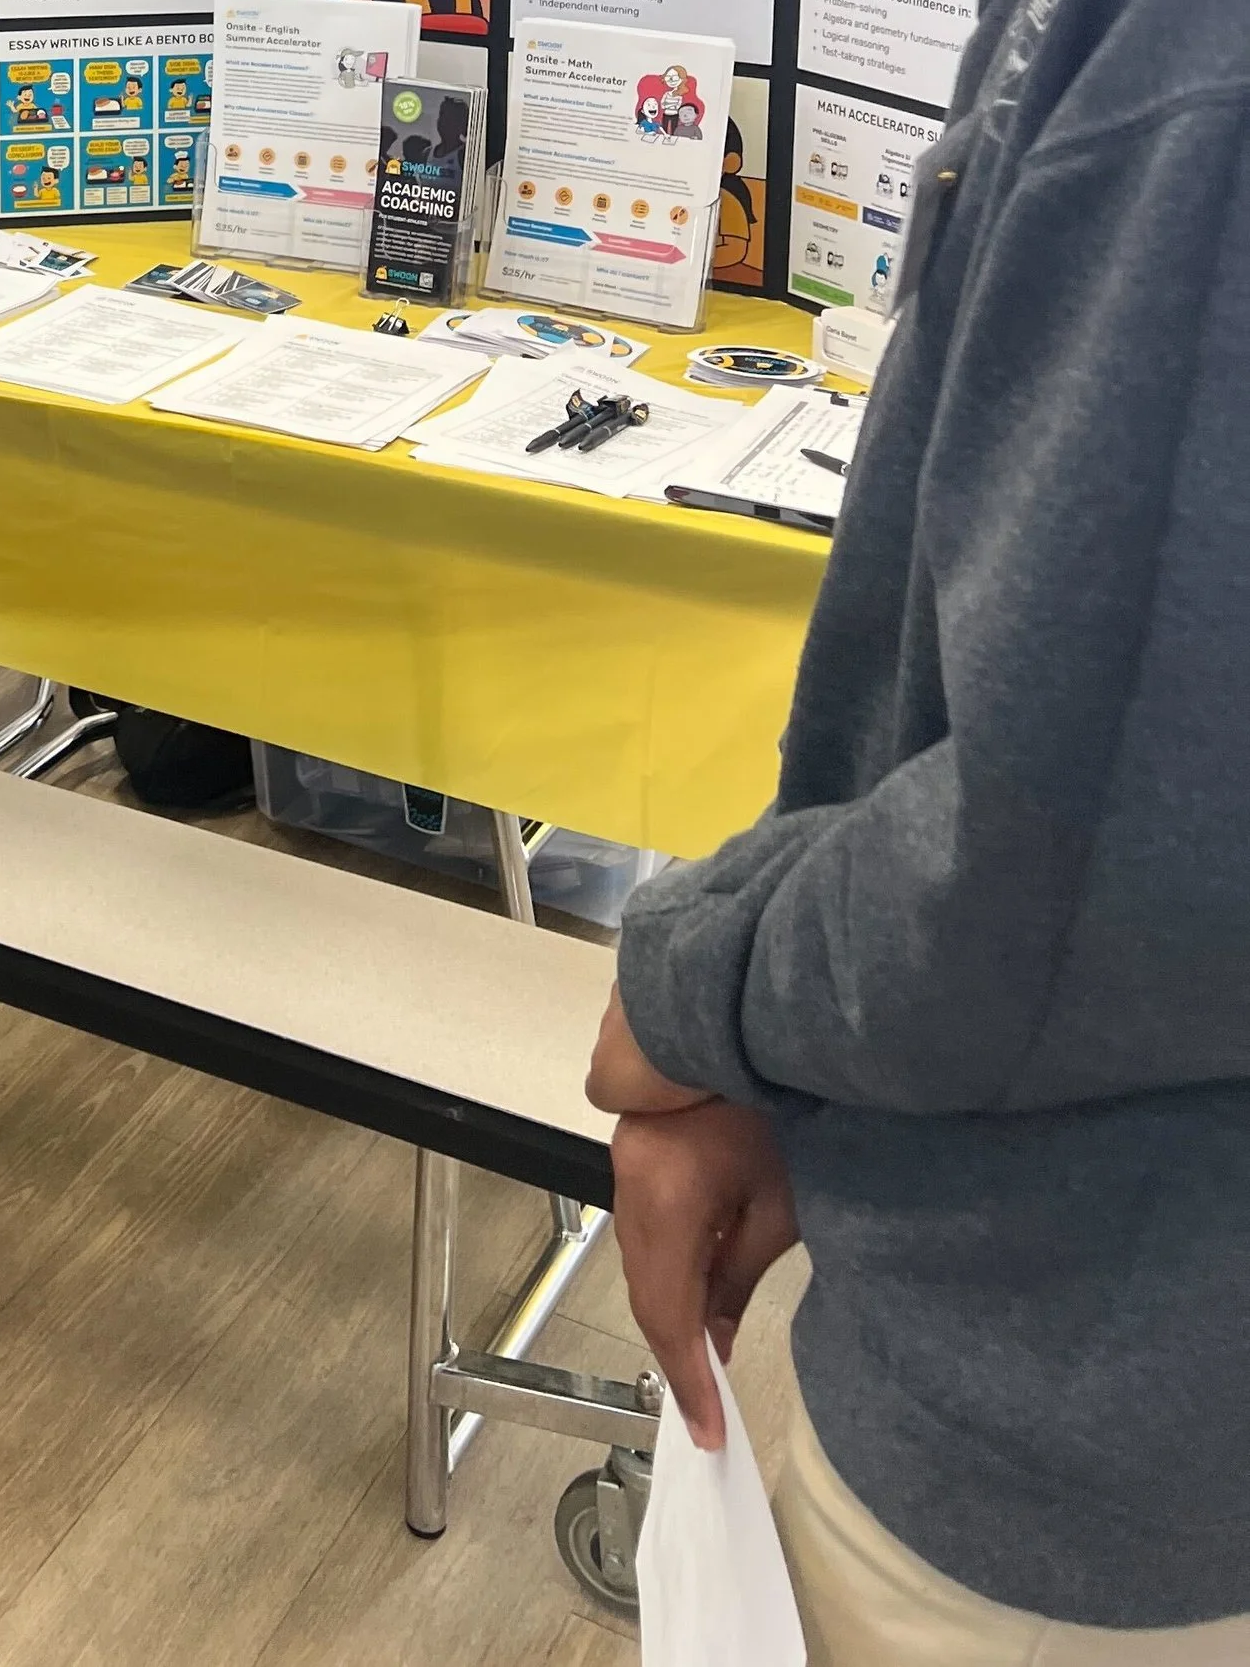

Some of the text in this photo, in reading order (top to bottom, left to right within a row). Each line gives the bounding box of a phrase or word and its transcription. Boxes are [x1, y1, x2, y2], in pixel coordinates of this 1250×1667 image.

[601, 3, 639, 17] learning
[958, 5, 972, 18] in:
[226, 22, 300, 35] Onsite English
[823, 12, 963, 53] Algebra and geometry fundamental
[9, 33, 214, 50] ESSAY WRITING IS LIKE A BENTO BO
[226, 34, 321, 47] Summer Accelerator
[822, 29, 890, 55] Logical reasoning
[526, 54, 593, 69] Onsite Math
[822, 45, 906, 75] Test-taking strategies
[525, 66, 567, 80] Summer
[568, 71, 627, 87] Accelerator
[817, 100, 846, 118] MATH
[848, 108, 924, 140] ACCELERATOR
[382, 181, 456, 204] ACADEMIC
[380, 195, 454, 218] COACHING
